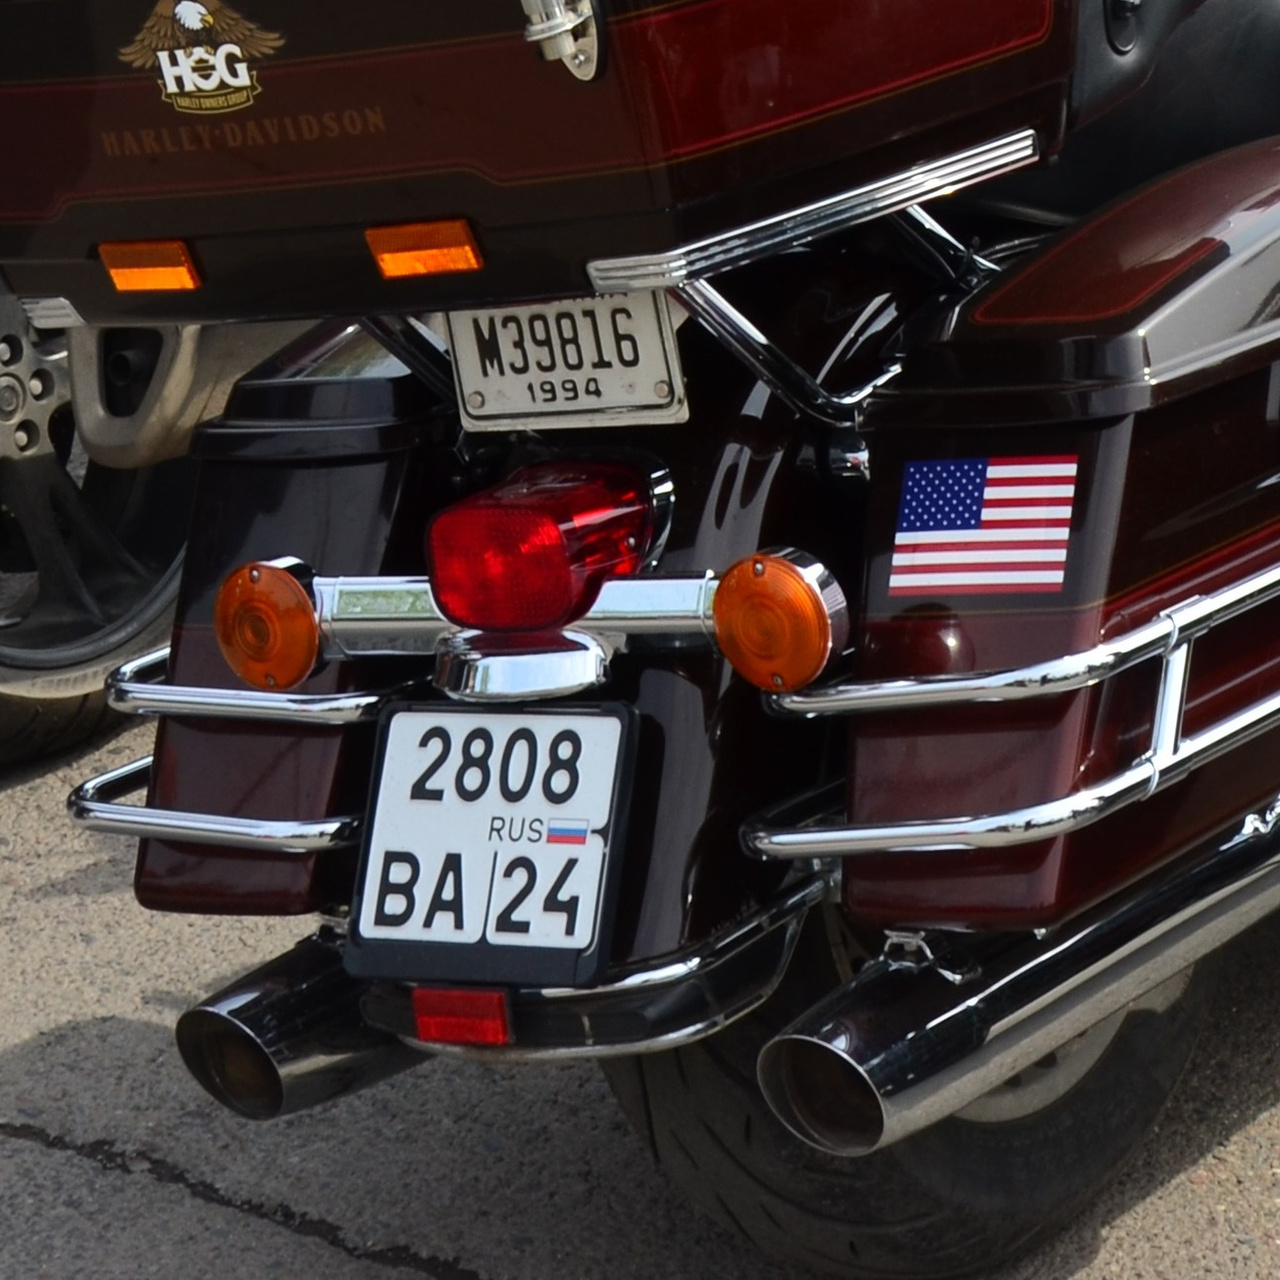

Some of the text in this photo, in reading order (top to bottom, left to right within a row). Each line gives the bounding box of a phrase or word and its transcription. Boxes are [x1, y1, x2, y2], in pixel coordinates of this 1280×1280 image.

[471, 306, 640, 379] M39816
[526, 376, 601, 404] 1994
[409, 725, 583, 805] 2808
[488, 816, 544, 843] RUS
[495, 856, 581, 937] 24
